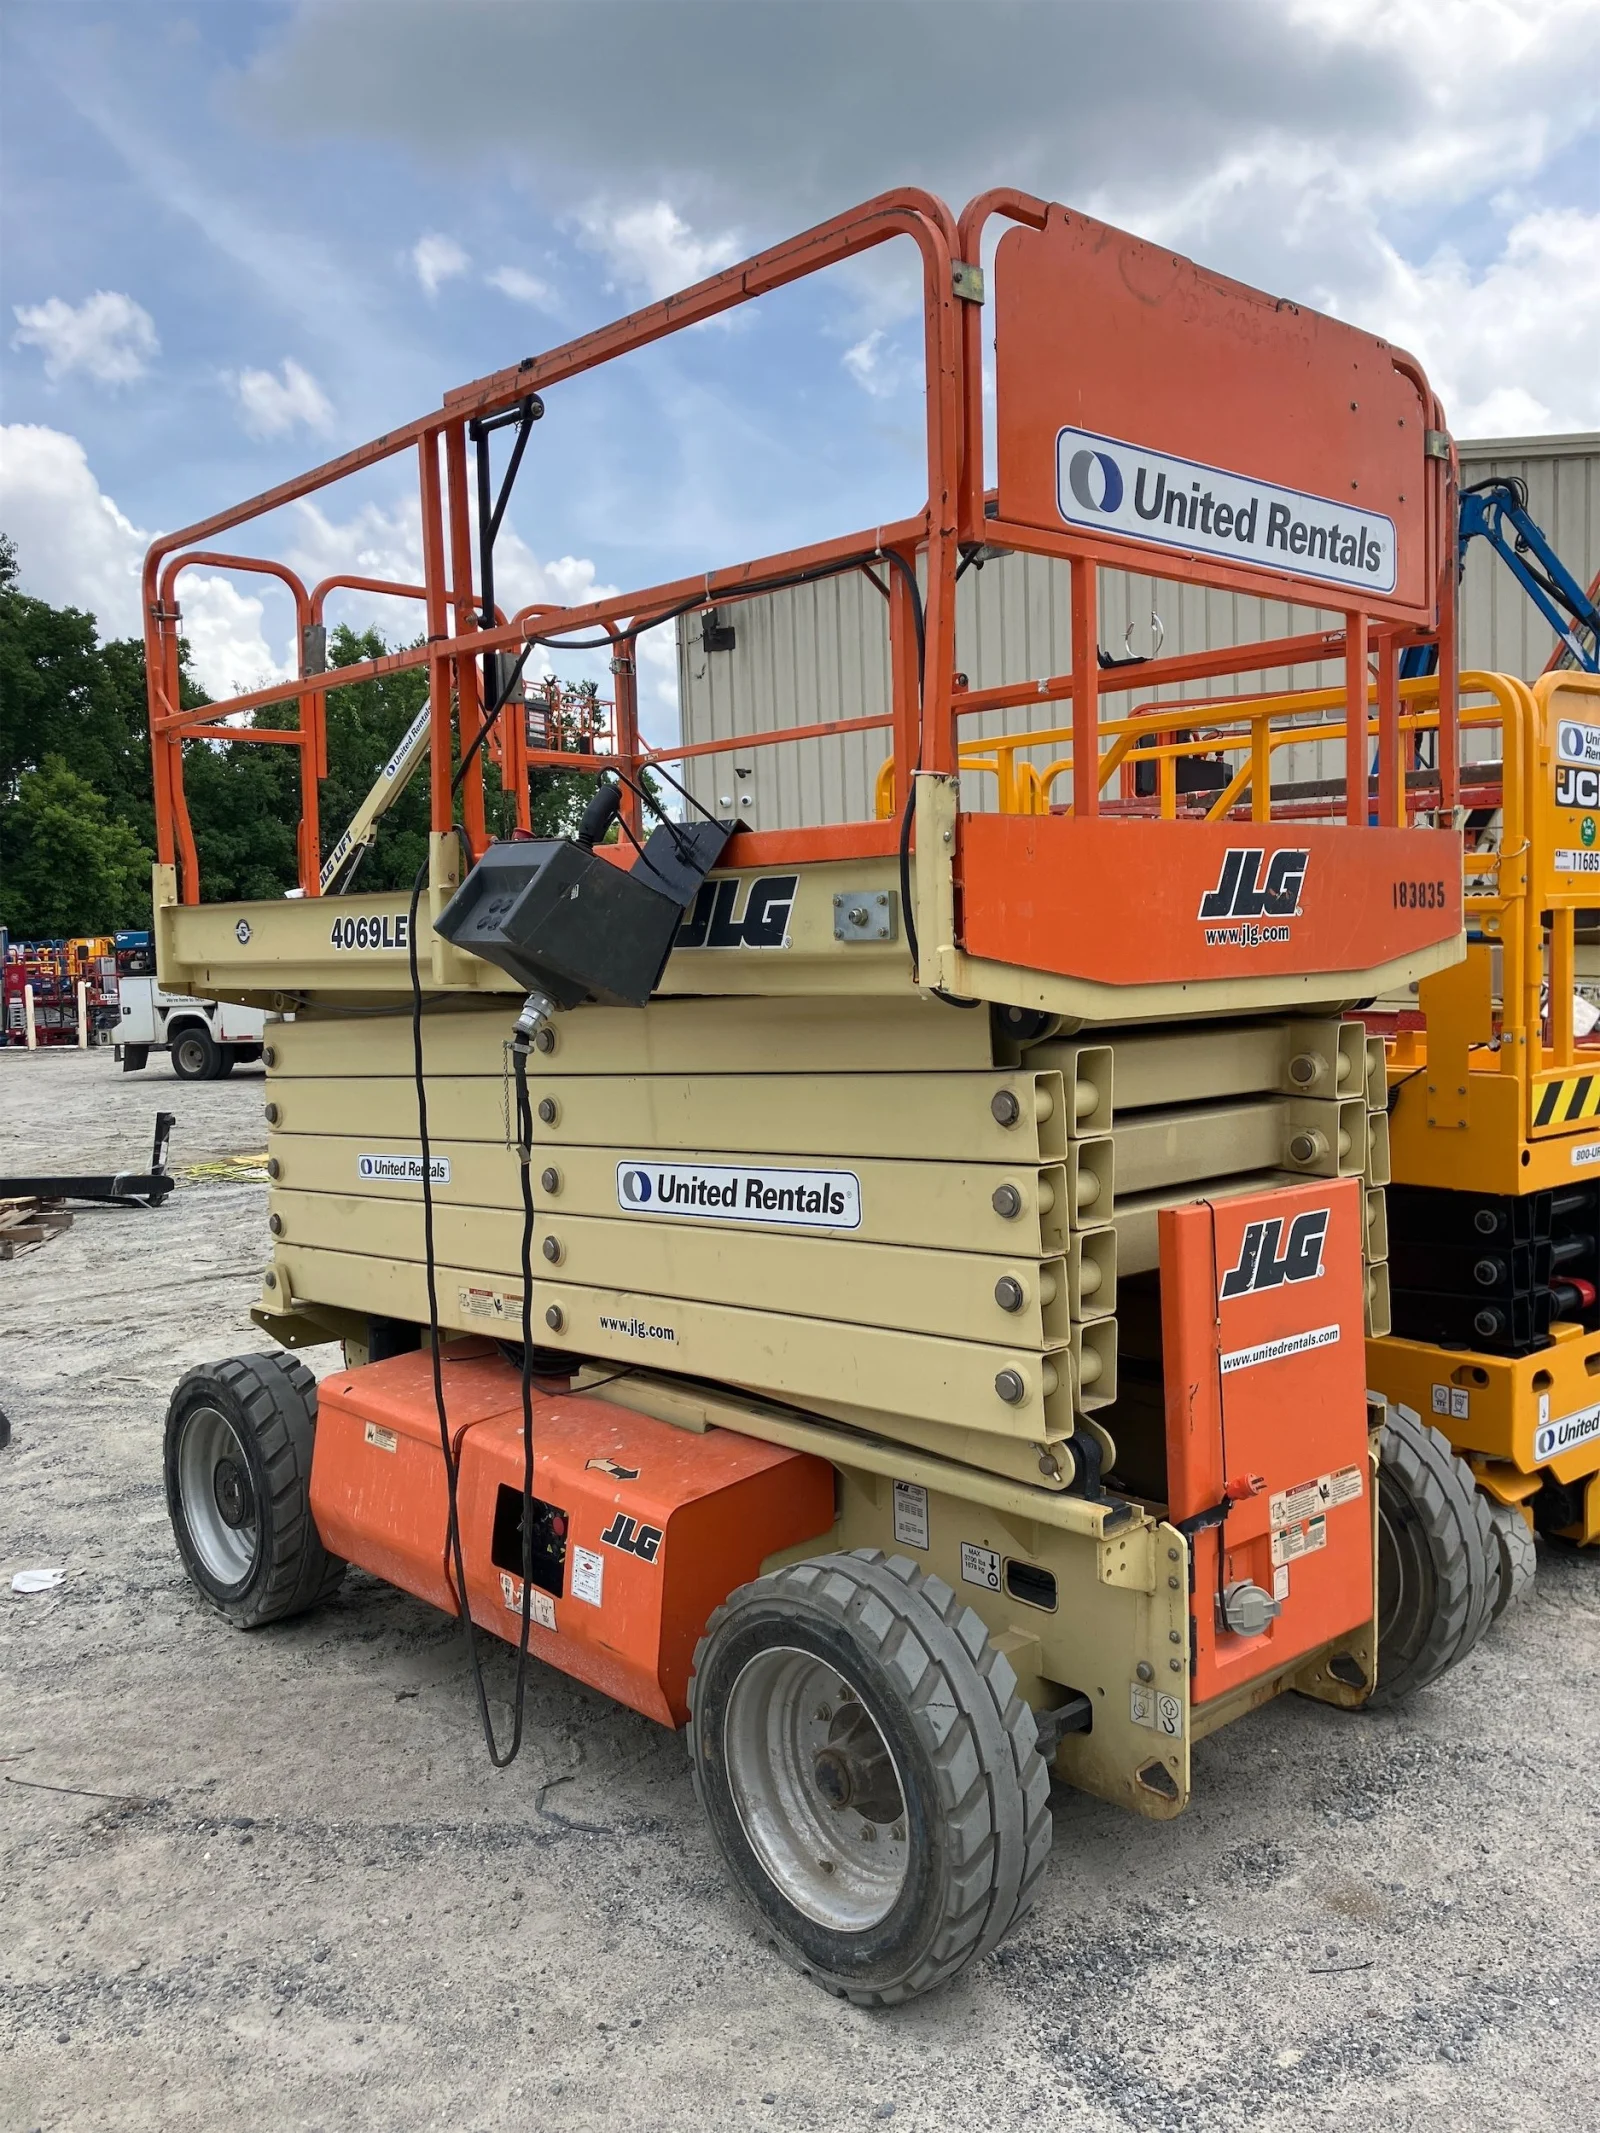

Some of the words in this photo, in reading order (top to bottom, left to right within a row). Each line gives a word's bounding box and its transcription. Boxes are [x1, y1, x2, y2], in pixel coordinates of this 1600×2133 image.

[1134, 468, 1259, 543] United
[1266, 502, 1381, 572] Rentals
[393, 737, 413, 766] United
[1557, 770, 1600, 807] JC
[334, 831, 352, 864] LIFT
[1573, 852, 1599, 871] 11685
[1199, 849, 1310, 919] JLG
[1393, 881, 1445, 910] 183835
[673, 876, 799, 947] JLG
[331, 915, 408, 949] 4069LE
[1205, 925, 1289, 946] www.jlg.com
[374, 1160, 406, 1176] United
[658, 1174, 738, 1208] United
[745, 1178, 845, 1215] Rentals
[1221, 1210, 1329, 1299] JLG
[599, 1317, 674, 1341] www.jlg.com
[1223, 1329, 1338, 1369] www.unitedrentals.com
[1558, 1411, 1600, 1445] United
[601, 1513, 664, 1563] JLG
[968, 1547, 981, 1557] MAX
